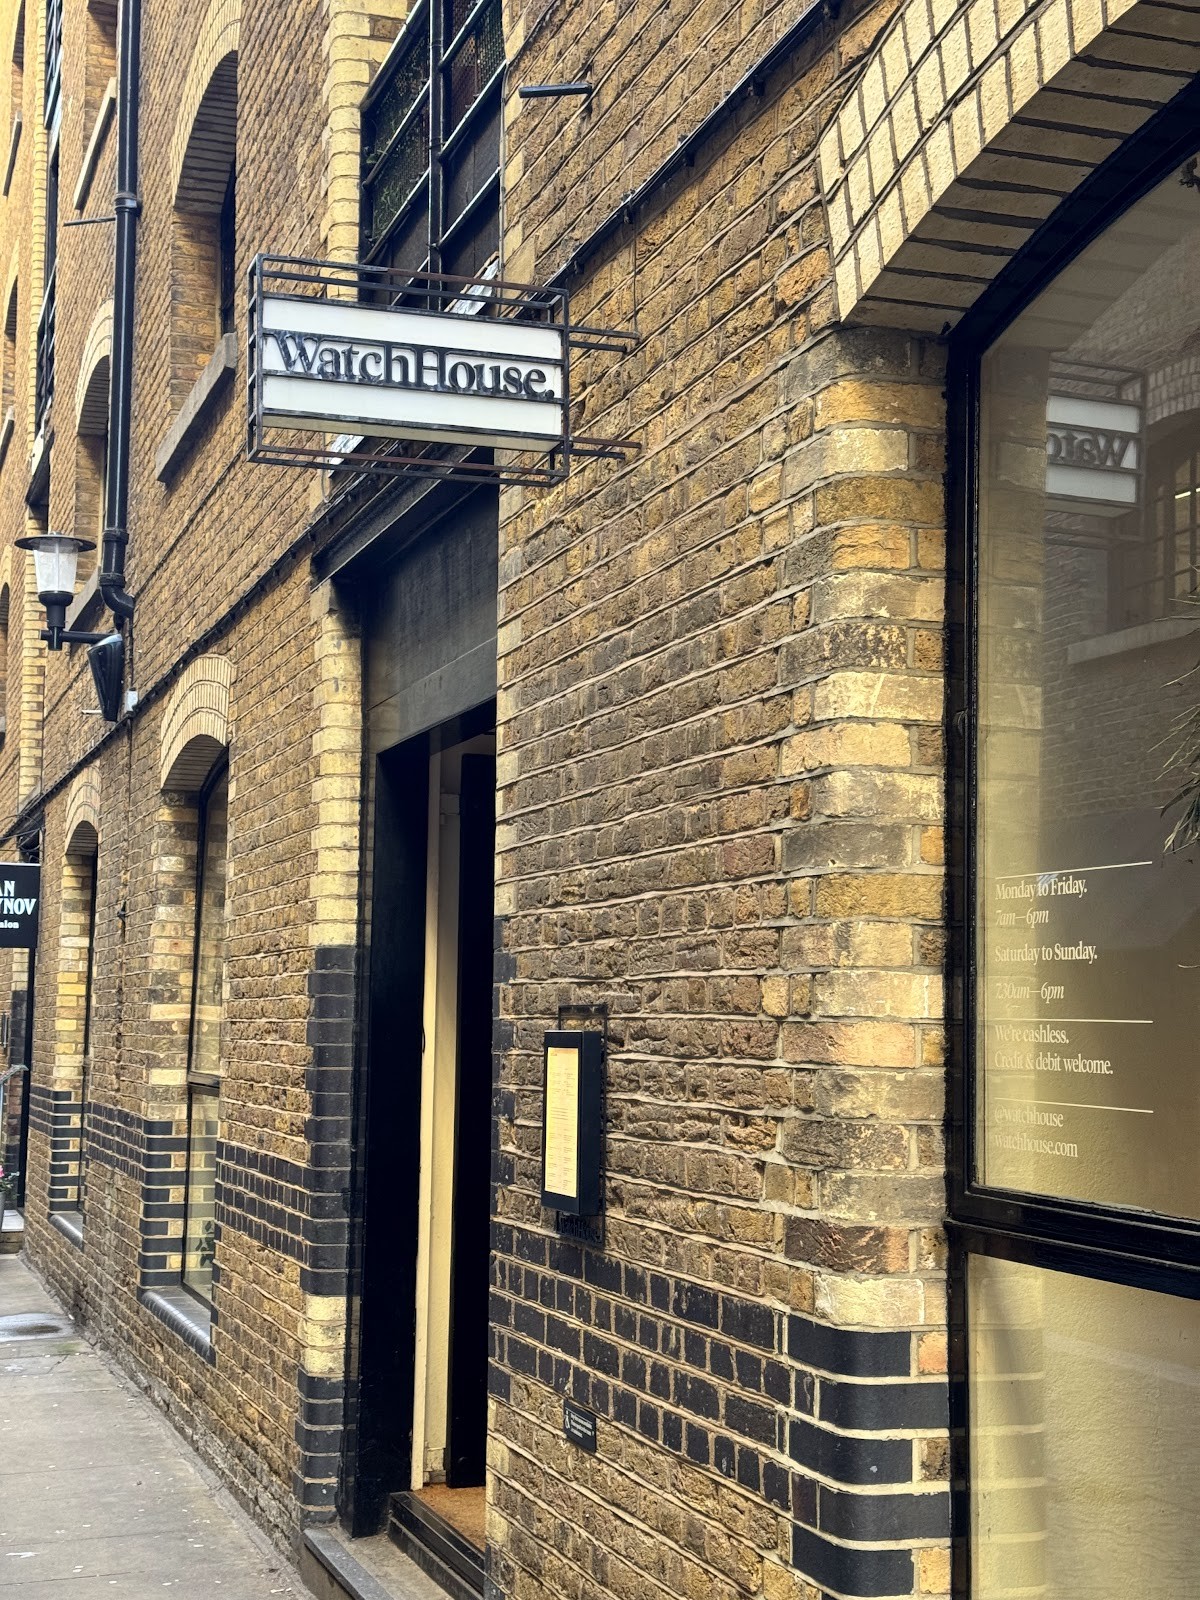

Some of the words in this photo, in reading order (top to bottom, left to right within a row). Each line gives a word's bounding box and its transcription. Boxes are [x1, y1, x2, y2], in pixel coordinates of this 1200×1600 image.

[0, 880, 15, 897] N
[995, 880, 1036, 901] Monday
[1037, 883, 1049, 896] to
[1050, 875, 1087, 898] Friday.
[995, 943, 1040, 965] Saturday
[1041, 947, 1052, 960] to
[1054, 941, 1097, 964] Sunday.
[1024, 1025, 1069, 1044] cashless.
[995, 1052, 1024, 1069] Credit
[1026, 1053, 1035, 1070] &
[1036, 1053, 1062, 1072] debit
[1063, 1054, 1113, 1074] welcome.
[995, 1105, 1064, 1127] @watchhouse
[995, 1132, 1078, 1157] watchhouse.com
